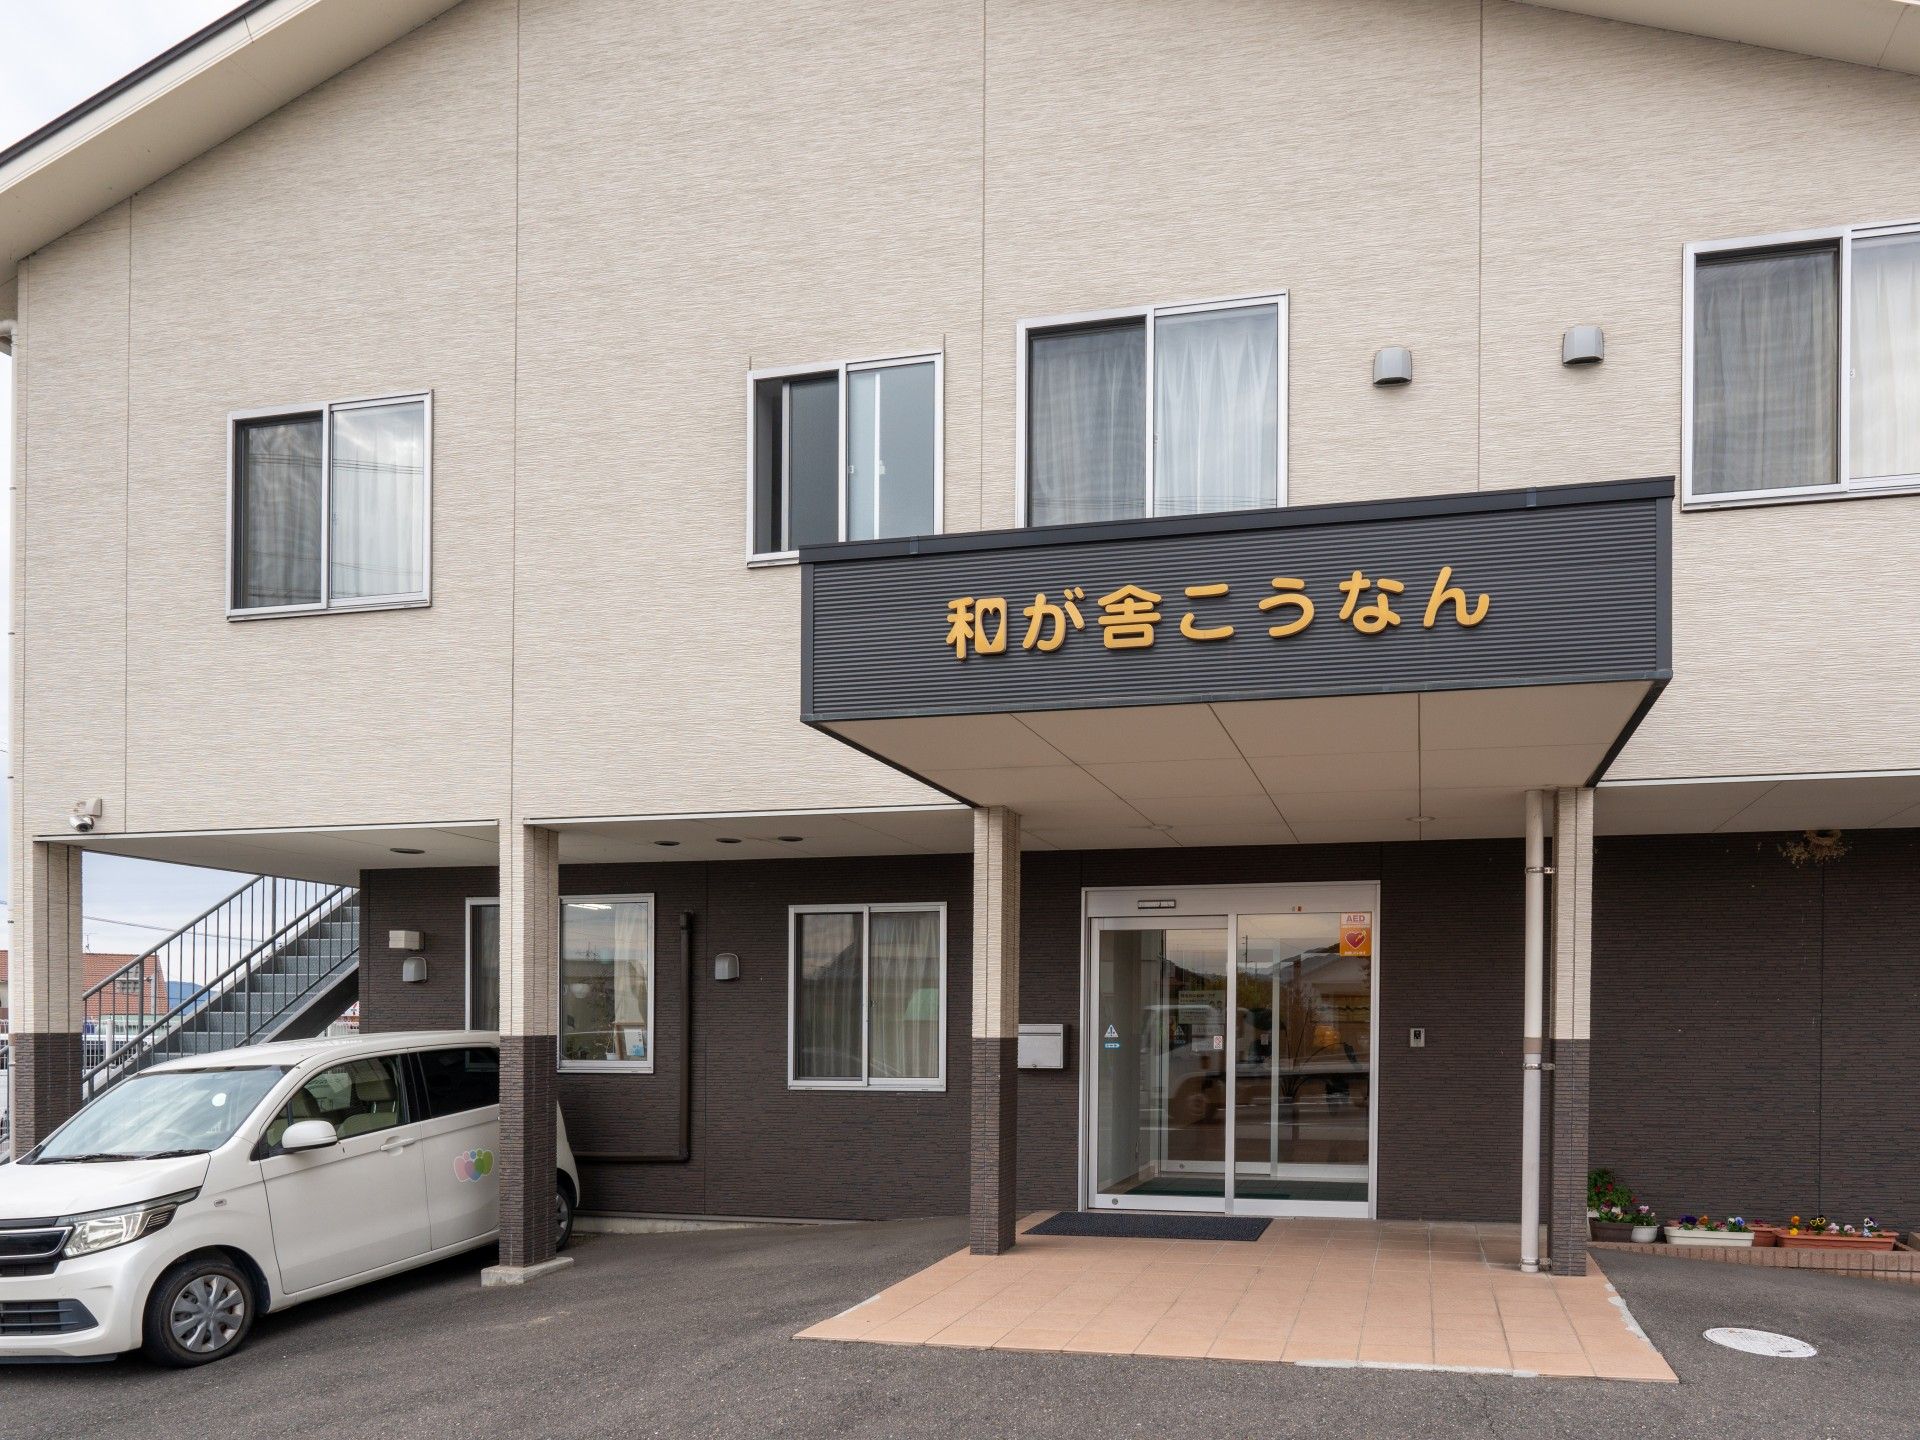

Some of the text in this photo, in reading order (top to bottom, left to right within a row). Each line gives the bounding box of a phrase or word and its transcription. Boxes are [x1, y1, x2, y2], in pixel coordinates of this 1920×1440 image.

[946, 566, 1490, 661] 和が舎こうなん
[1346, 914, 1366, 922] AED
